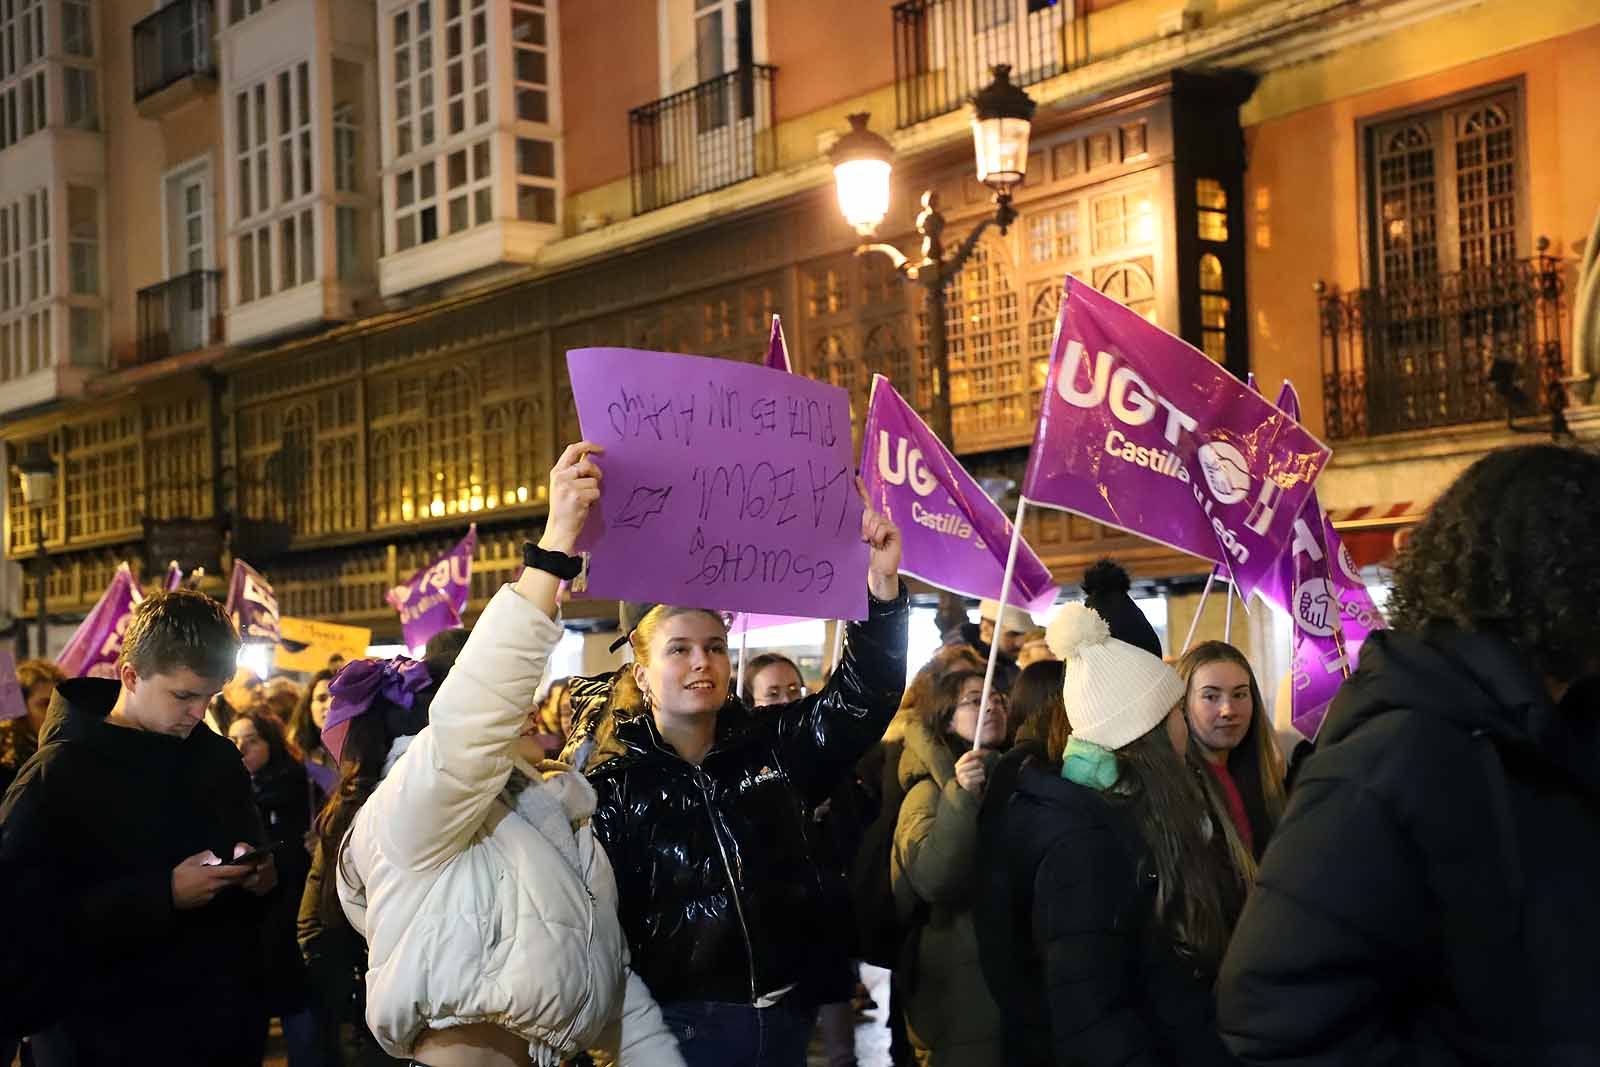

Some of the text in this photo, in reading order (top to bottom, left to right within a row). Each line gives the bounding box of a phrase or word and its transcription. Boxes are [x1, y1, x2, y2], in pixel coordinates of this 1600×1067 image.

[708, 381, 742, 431] UN
[751, 397, 776, 437] ES
[1057, 341, 1199, 446] UGT
[784, 395, 837, 447] PUTA
[878, 430, 957, 505] UG
[1105, 431, 1191, 486] Castilla
[808, 459, 848, 537] LA
[911, 502, 972, 539] Castilla
